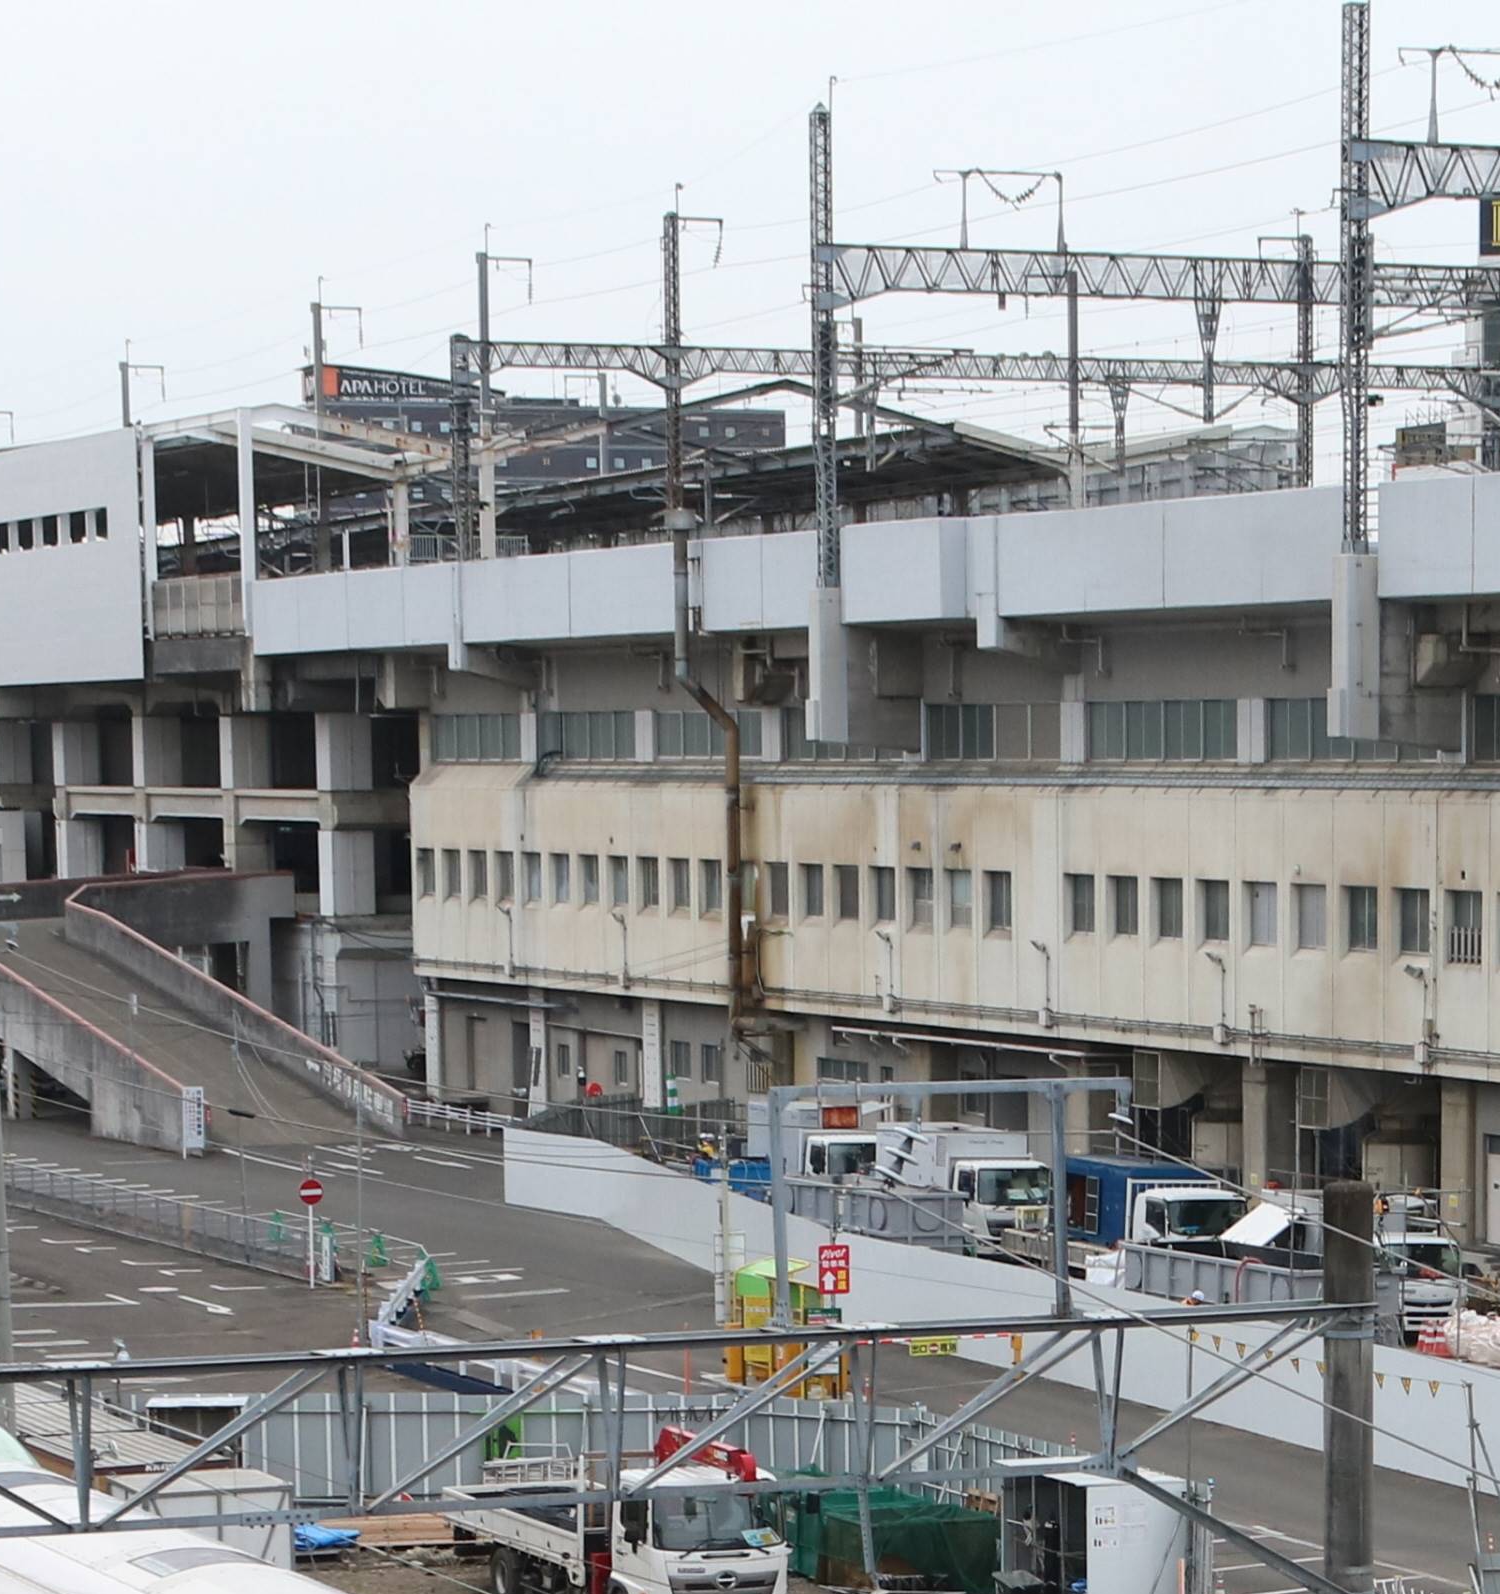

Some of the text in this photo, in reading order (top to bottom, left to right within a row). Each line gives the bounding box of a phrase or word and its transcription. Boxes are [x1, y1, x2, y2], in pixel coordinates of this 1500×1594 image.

[340, 379, 426, 396] APA HOTEL
[821, 1247, 846, 1260] Pivot
